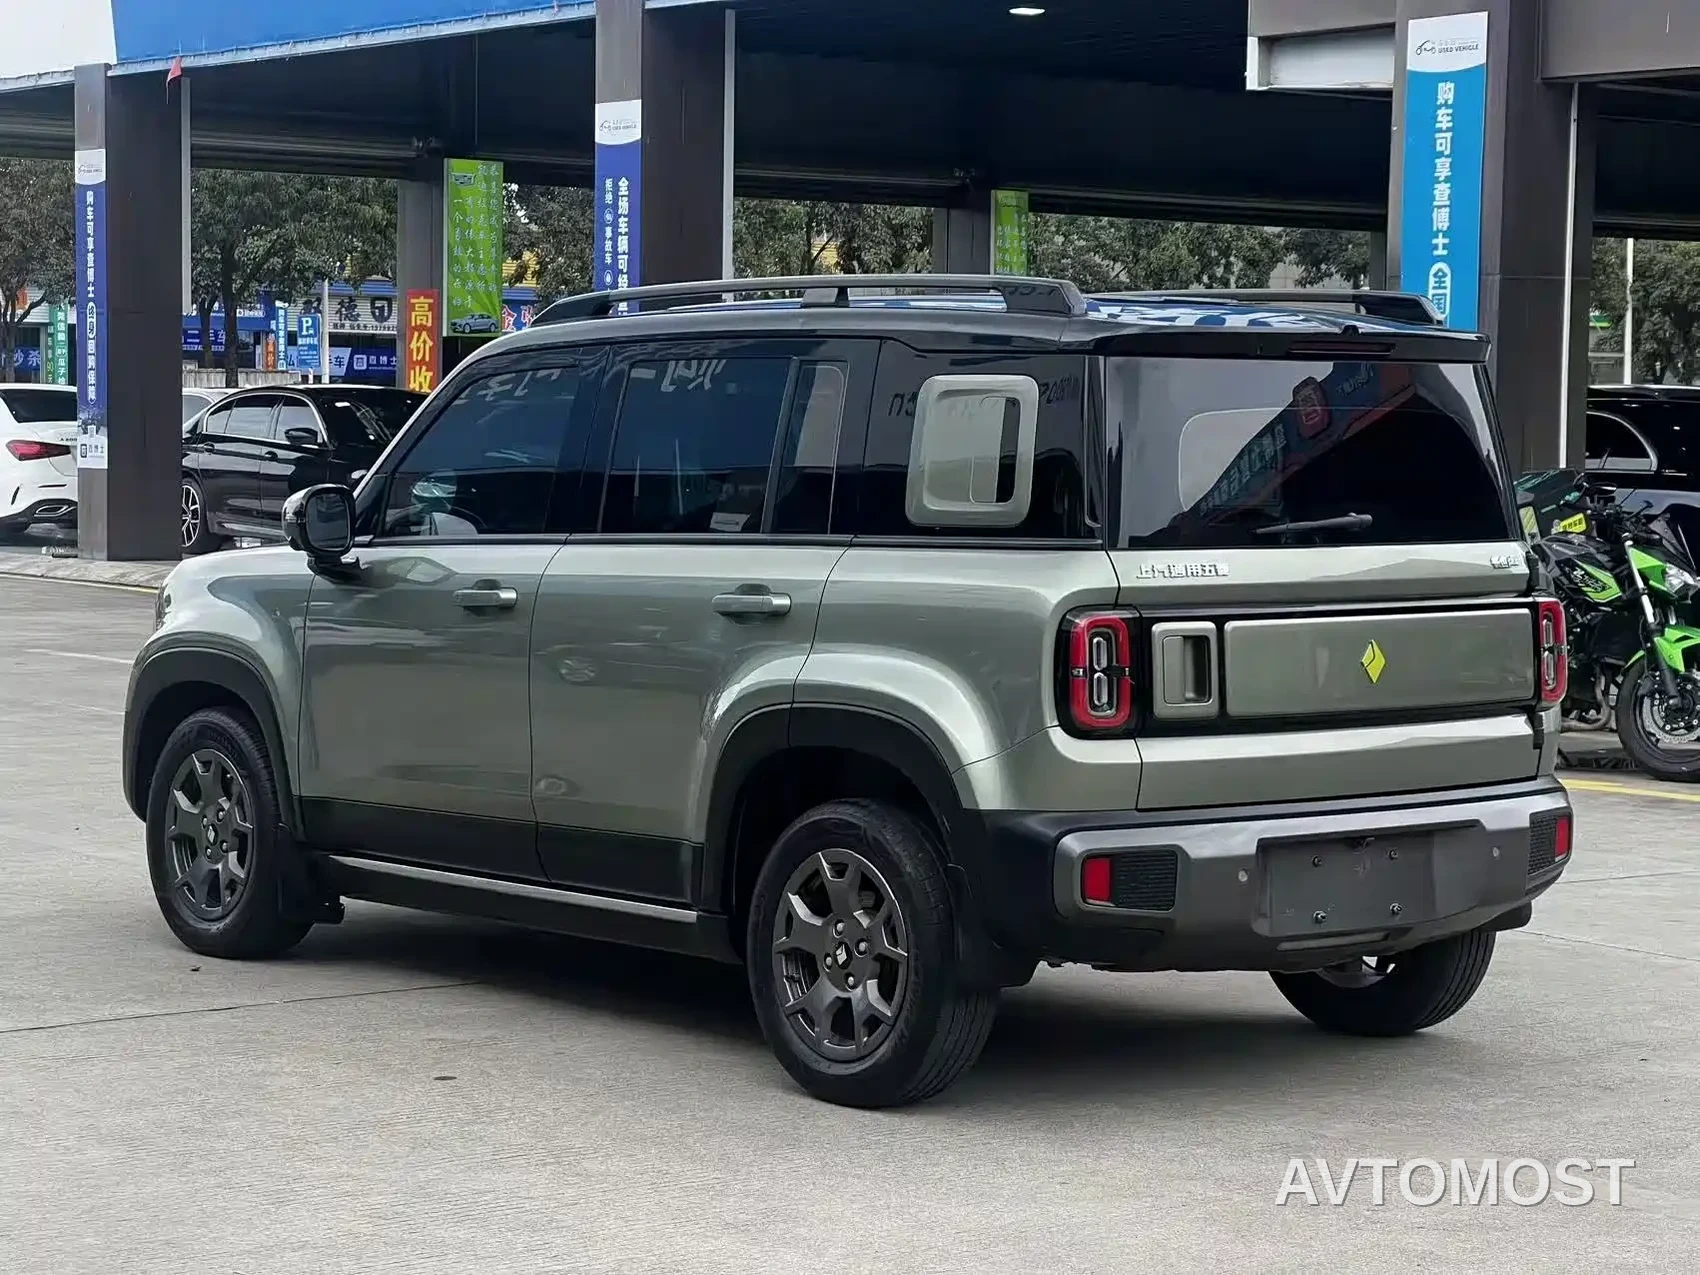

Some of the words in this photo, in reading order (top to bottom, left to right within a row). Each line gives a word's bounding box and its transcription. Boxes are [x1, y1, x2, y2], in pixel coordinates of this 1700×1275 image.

[1454, 43, 1479, 52] VEHICLE
[1431, 81, 1455, 257] 购车可享查博士
[604, 226, 613, 265] 事故车
[301, 317, 313, 336] P
[409, 296, 434, 393] 高价收
